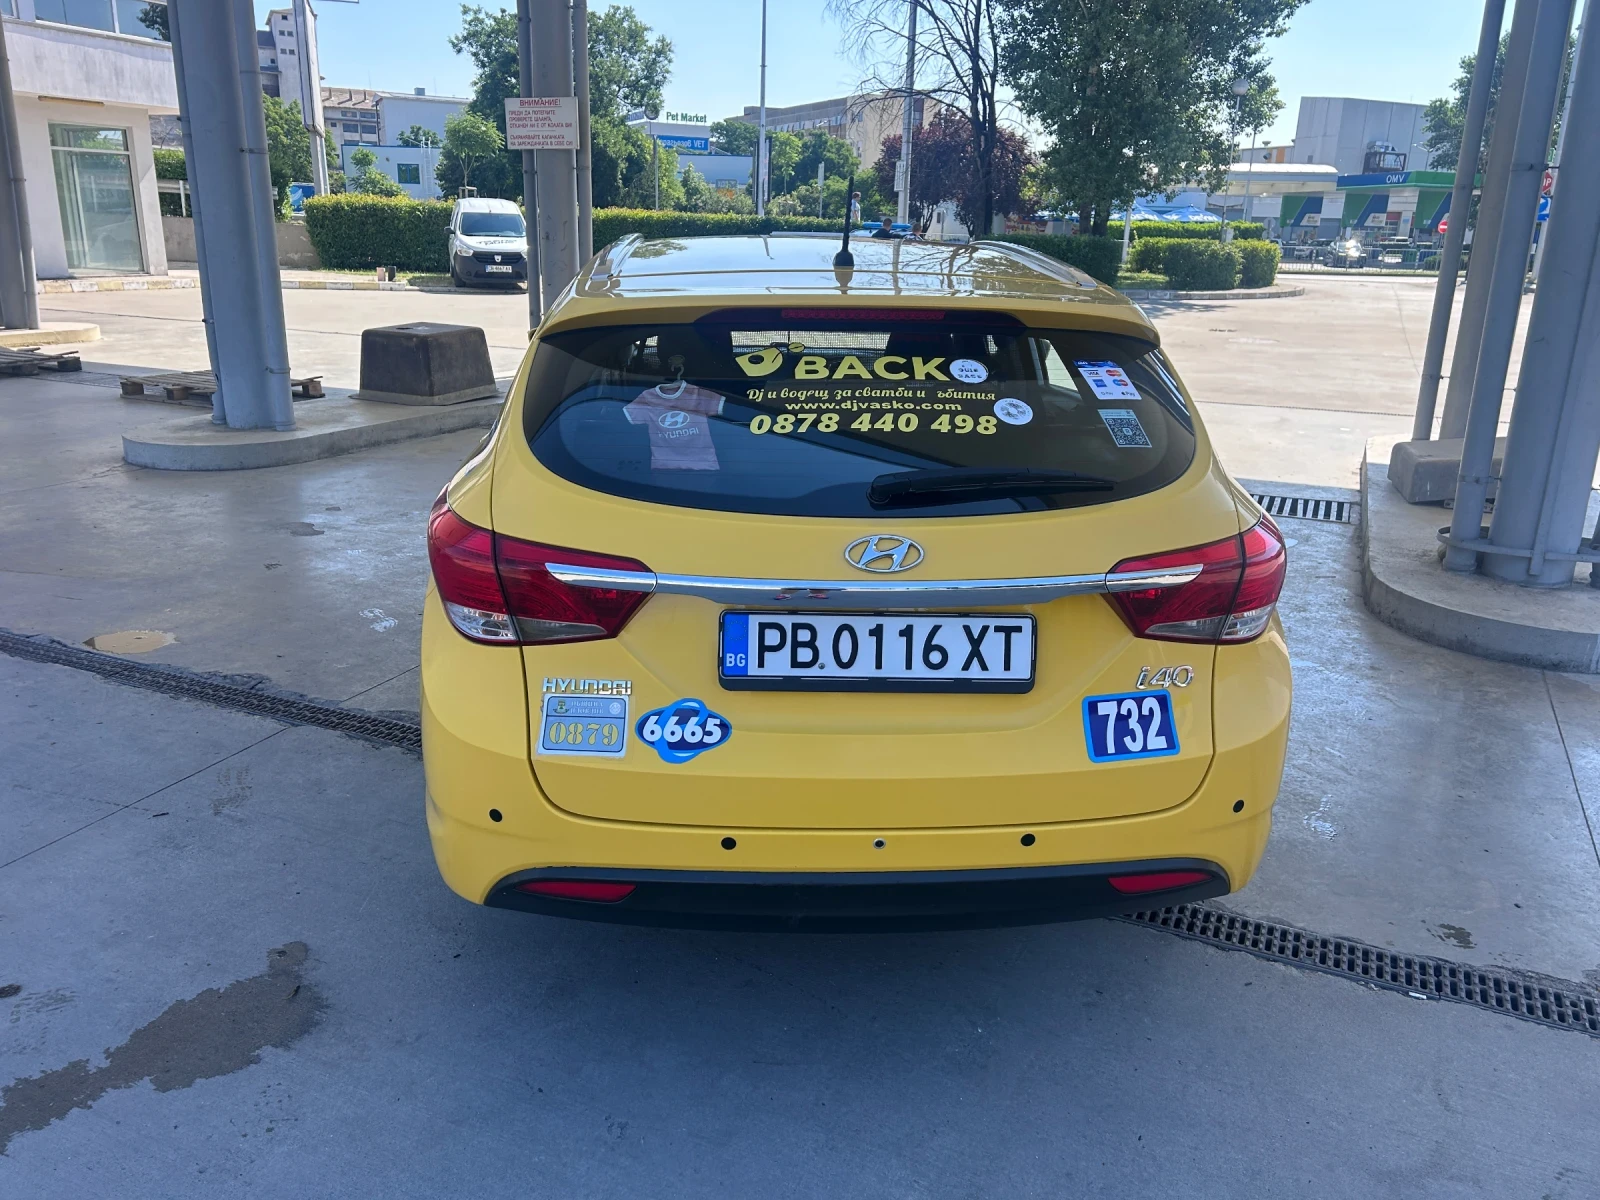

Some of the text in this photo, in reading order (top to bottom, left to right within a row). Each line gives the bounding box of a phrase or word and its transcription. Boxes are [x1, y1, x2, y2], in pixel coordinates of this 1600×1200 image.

[666, 112, 706, 122] Pet Market
[1386, 174, 1405, 183] OMV
[794, 356, 950, 381] BACK
[747, 388, 764, 402] Dj
[768, 390, 776, 398] и
[834, 389, 851, 400] за
[855, 387, 913, 397] сватби
[785, 401, 962, 411] www.djvasko.com
[658, 428, 699, 439] HYUNDAI
[750, 413, 998, 435] 0878 440 498
[961, 624, 1023, 671] XT
[726, 653, 746, 667] BG
[542, 678, 632, 694] HYUNDAI
[1136, 665, 1194, 689] i40
[549, 722, 620, 746] 0879
[643, 715, 722, 744] 6665
[1097, 697, 1168, 754] 732
